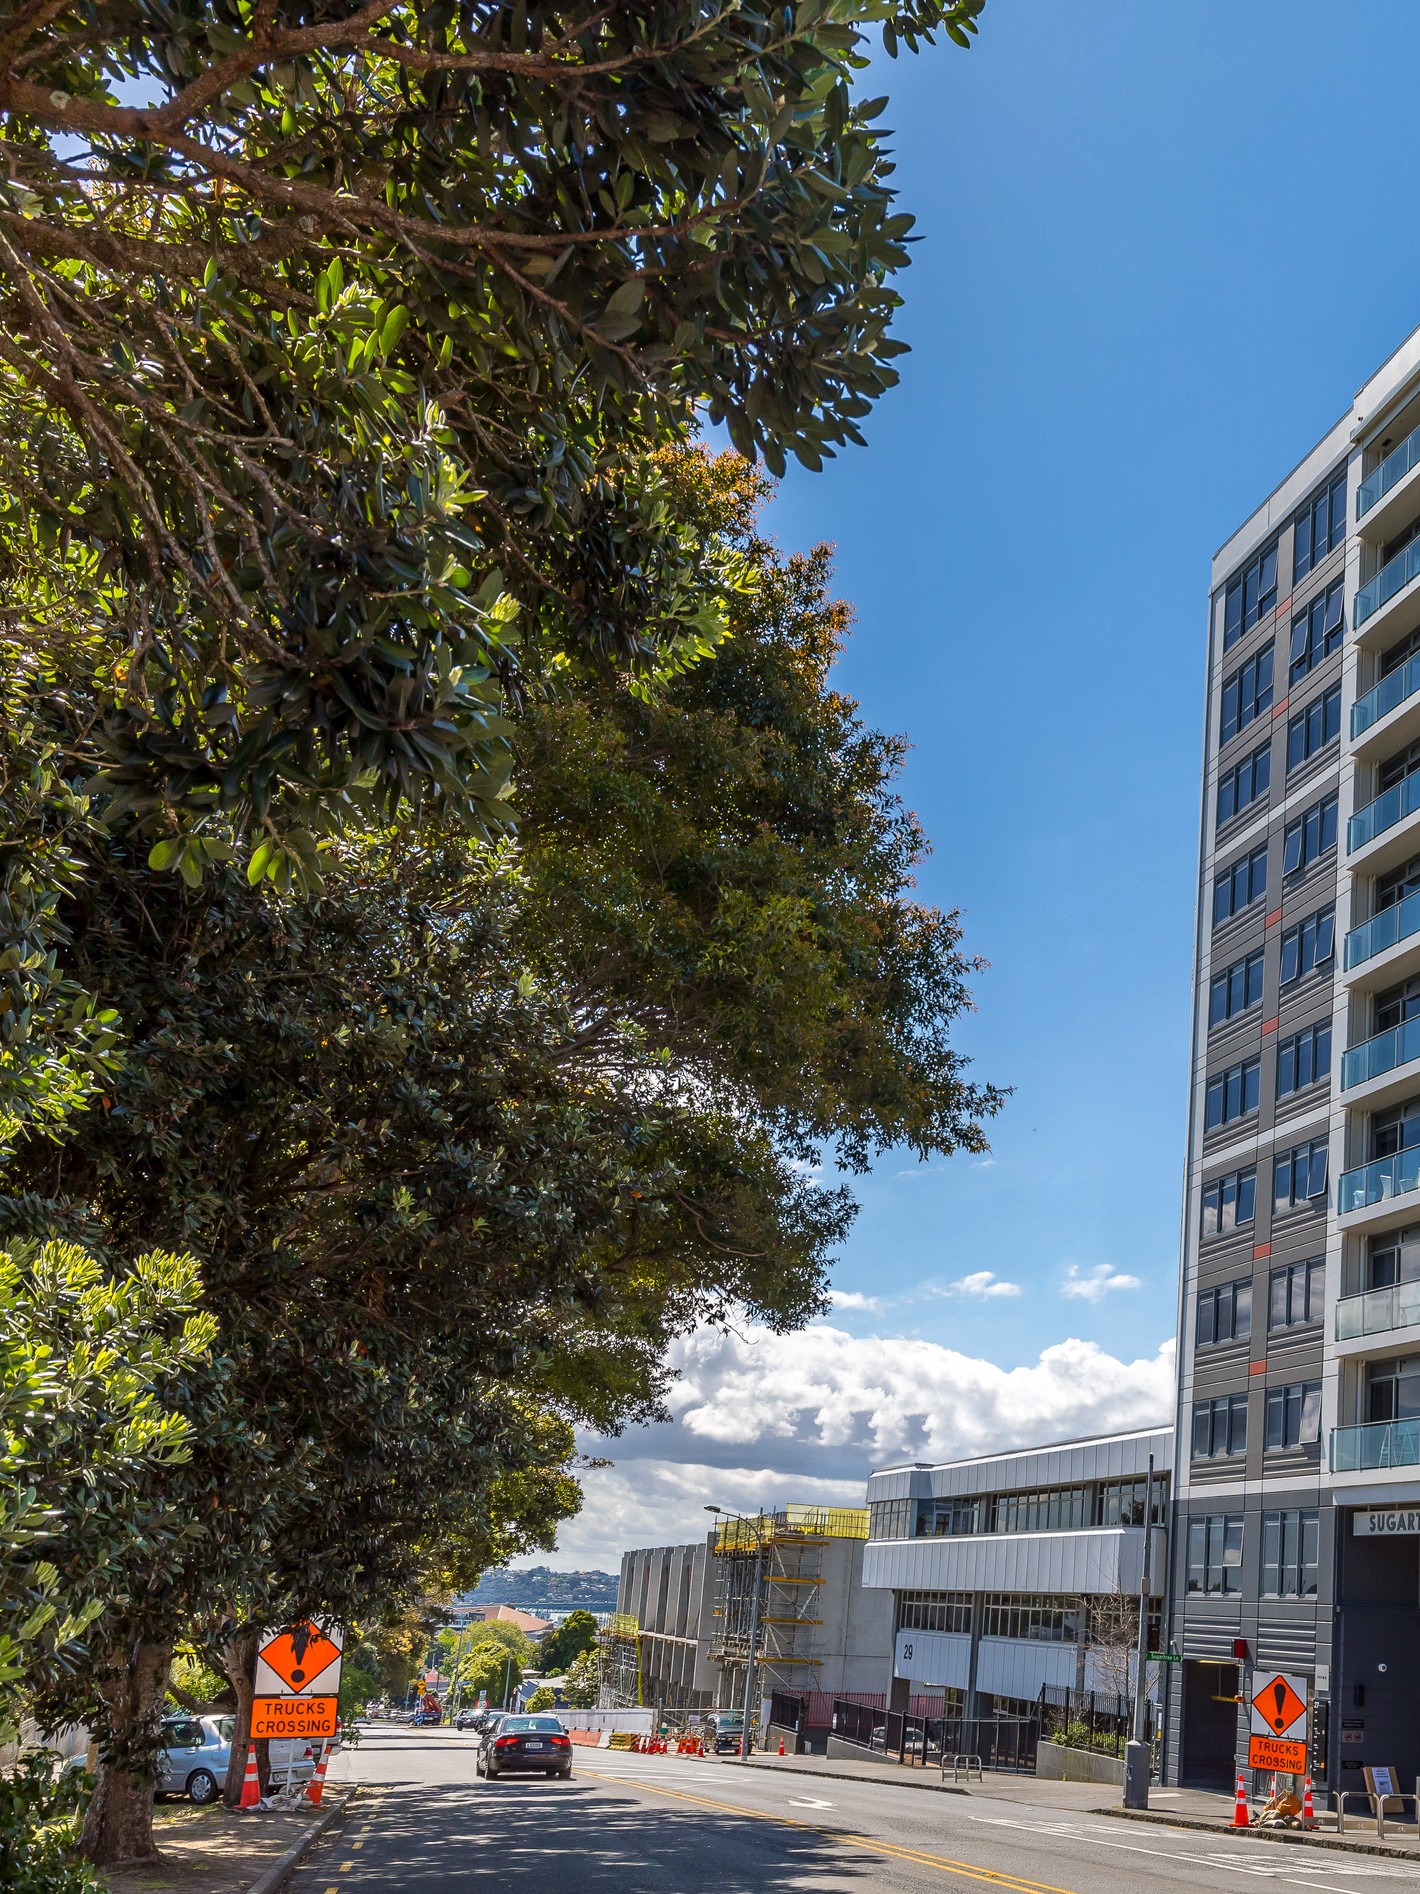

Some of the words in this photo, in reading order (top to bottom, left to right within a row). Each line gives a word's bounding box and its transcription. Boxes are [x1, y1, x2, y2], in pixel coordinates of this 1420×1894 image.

[903, 1643, 913, 1660] 29
[1151, 1653, 1173, 1661] Sugartree
[265, 1702, 326, 1715] TRUCKS
[256, 1719, 331, 1733] CROSSING
[1258, 1740, 1299, 1757] TRUCKS
[1252, 1753, 1303, 1771] CROSSING
